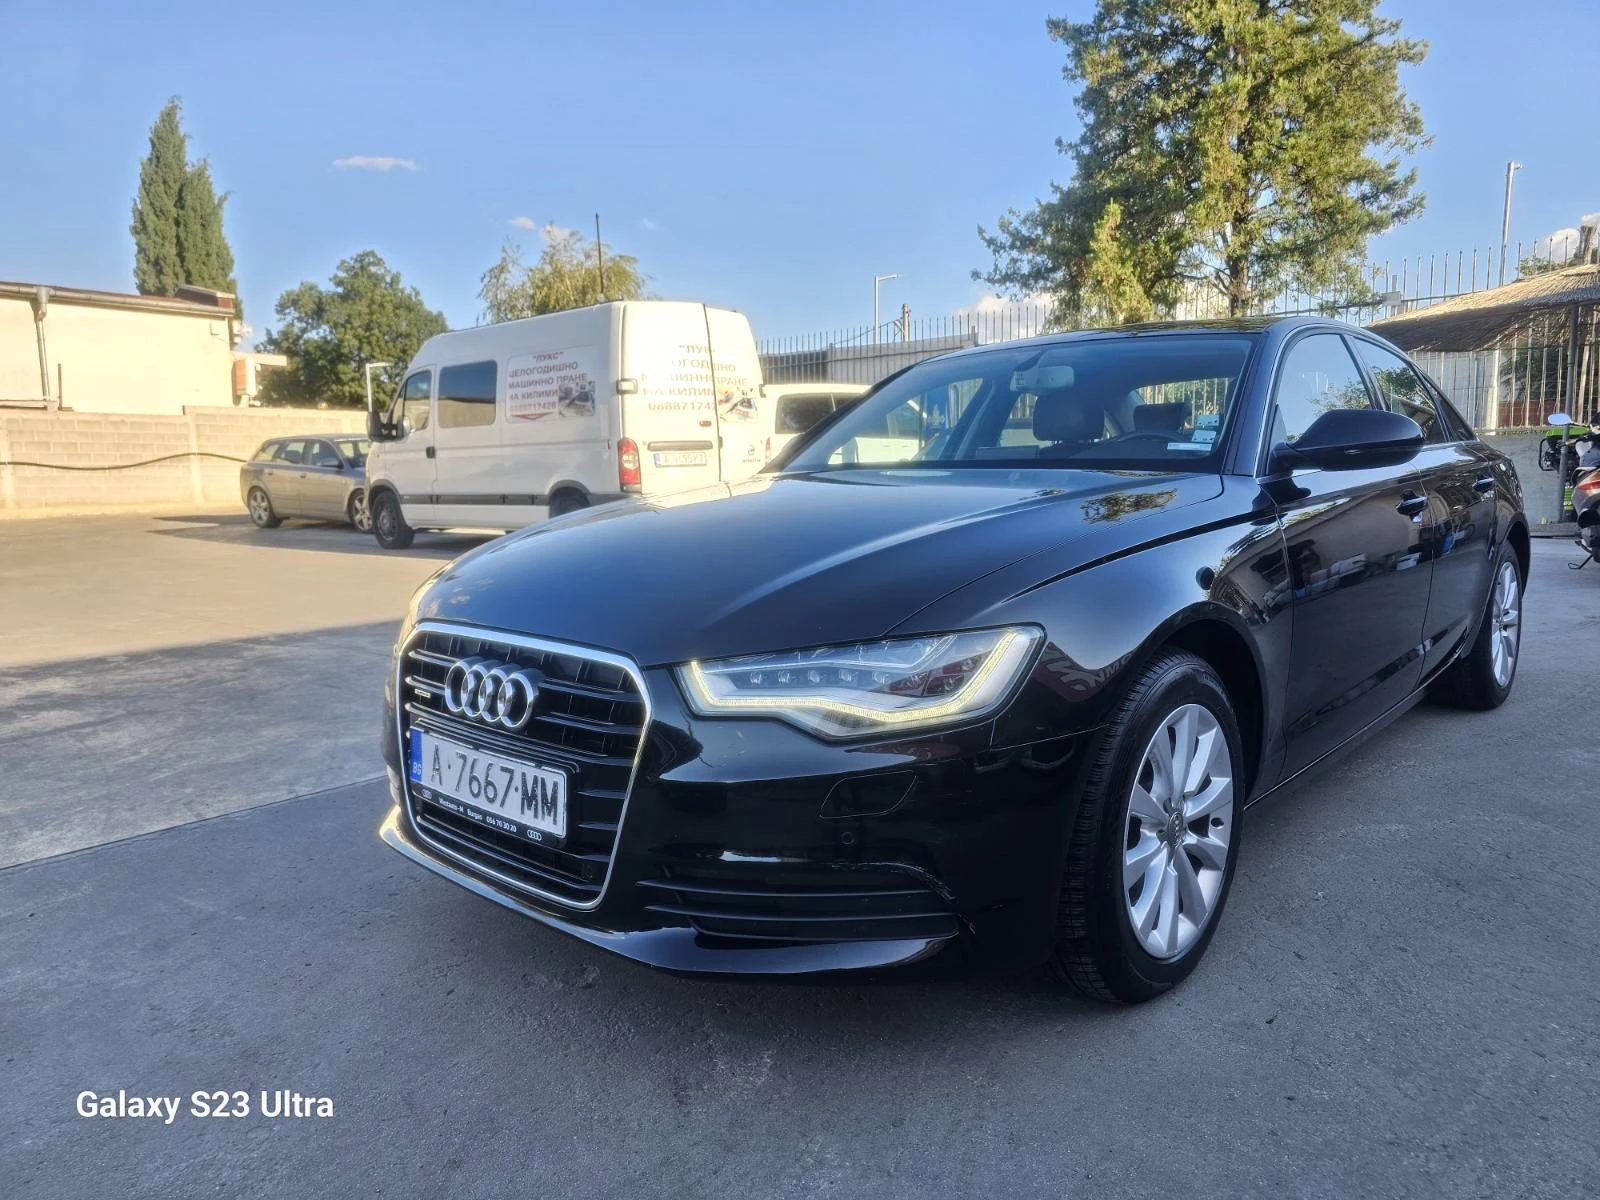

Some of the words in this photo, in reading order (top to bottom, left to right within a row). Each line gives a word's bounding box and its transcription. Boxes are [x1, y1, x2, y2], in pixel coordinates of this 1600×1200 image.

[509, 361, 578, 378] ЦЕЛОГОДИШНО
[509, 376, 554, 389] МАШИННО
[556, 373, 588, 385] ПРАНЕ
[521, 389, 558, 401] КИЛИМИ
[668, 387, 715, 396] КИЛИМ
[412, 761, 422, 776] BG
